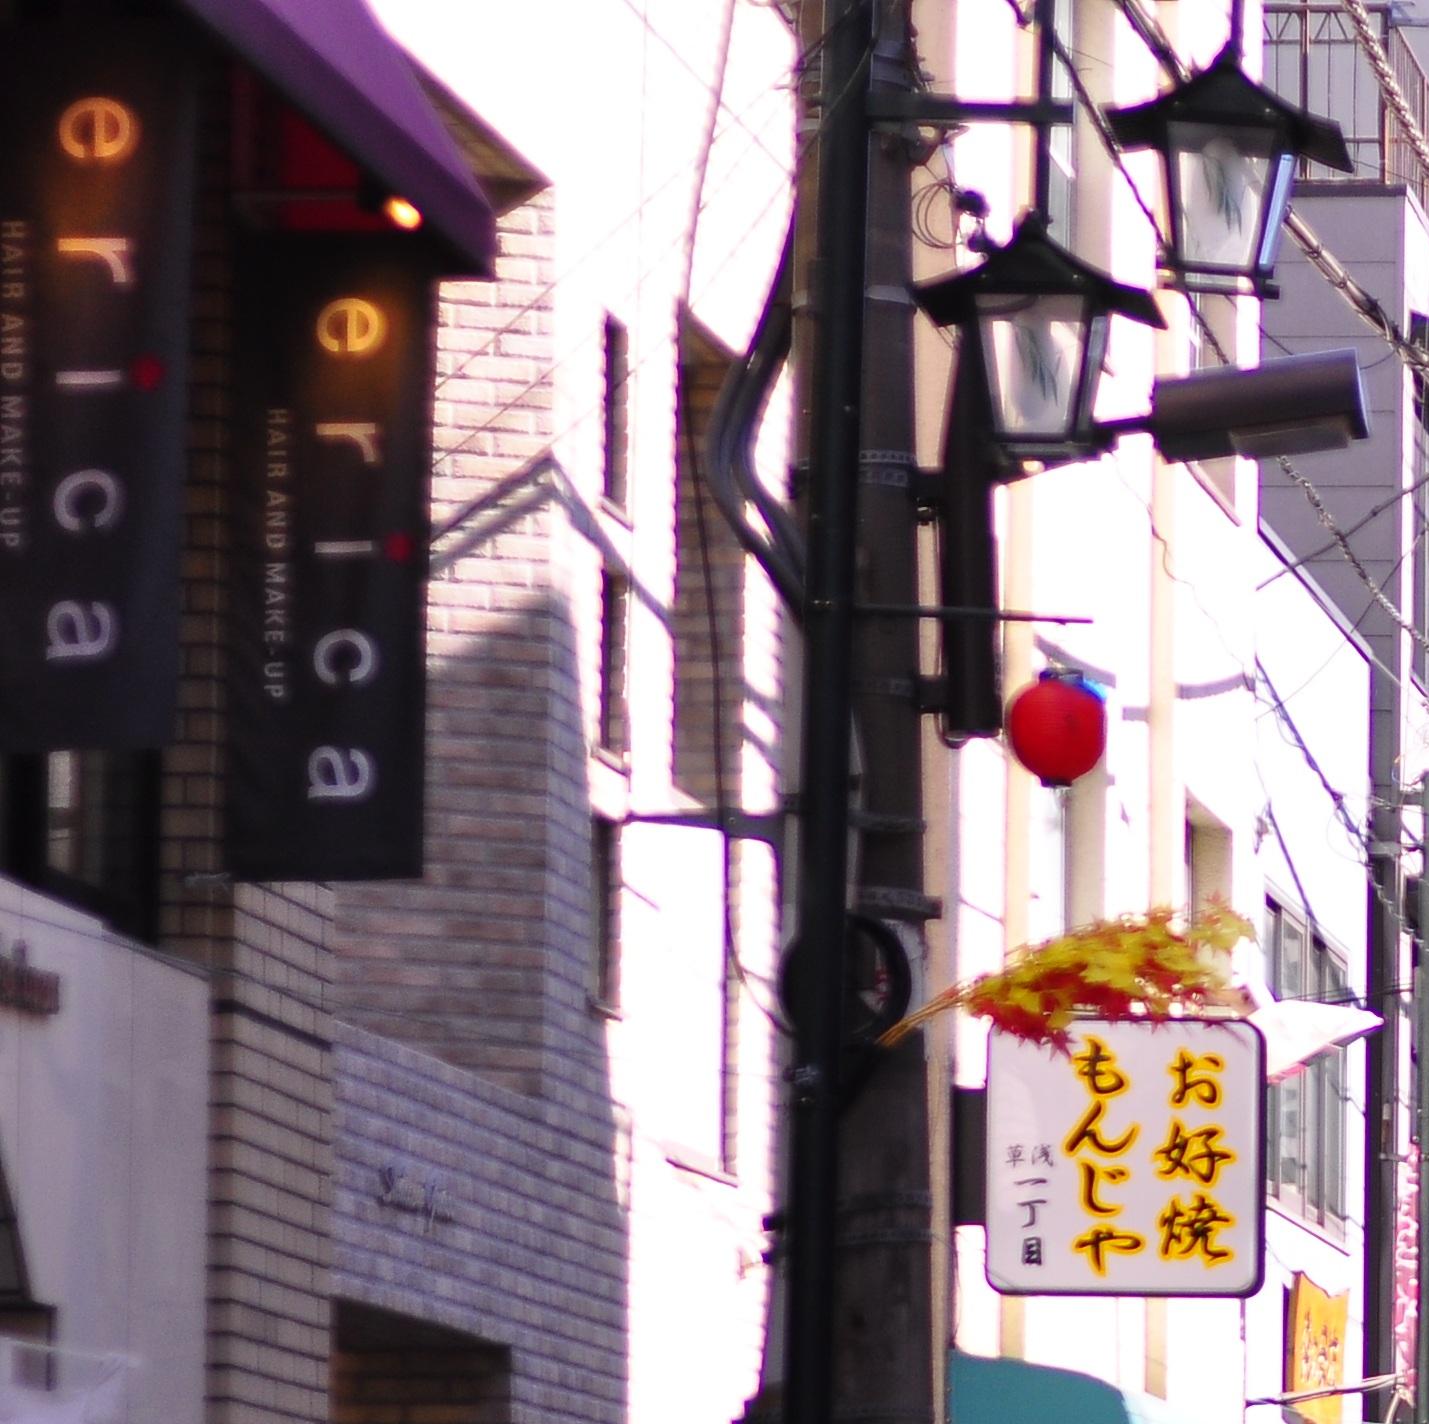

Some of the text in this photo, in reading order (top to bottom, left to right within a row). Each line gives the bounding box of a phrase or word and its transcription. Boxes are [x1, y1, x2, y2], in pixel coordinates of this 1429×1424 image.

[0, 219, 26, 299] HAIR
[0, 314, 25, 381] AND
[46, 96, 164, 662] erica
[263, 407, 290, 699] HAIR AND MAKE-UP
[308, 297, 414, 800] erica
[1154, 1048, 1236, 1267] お好焼
